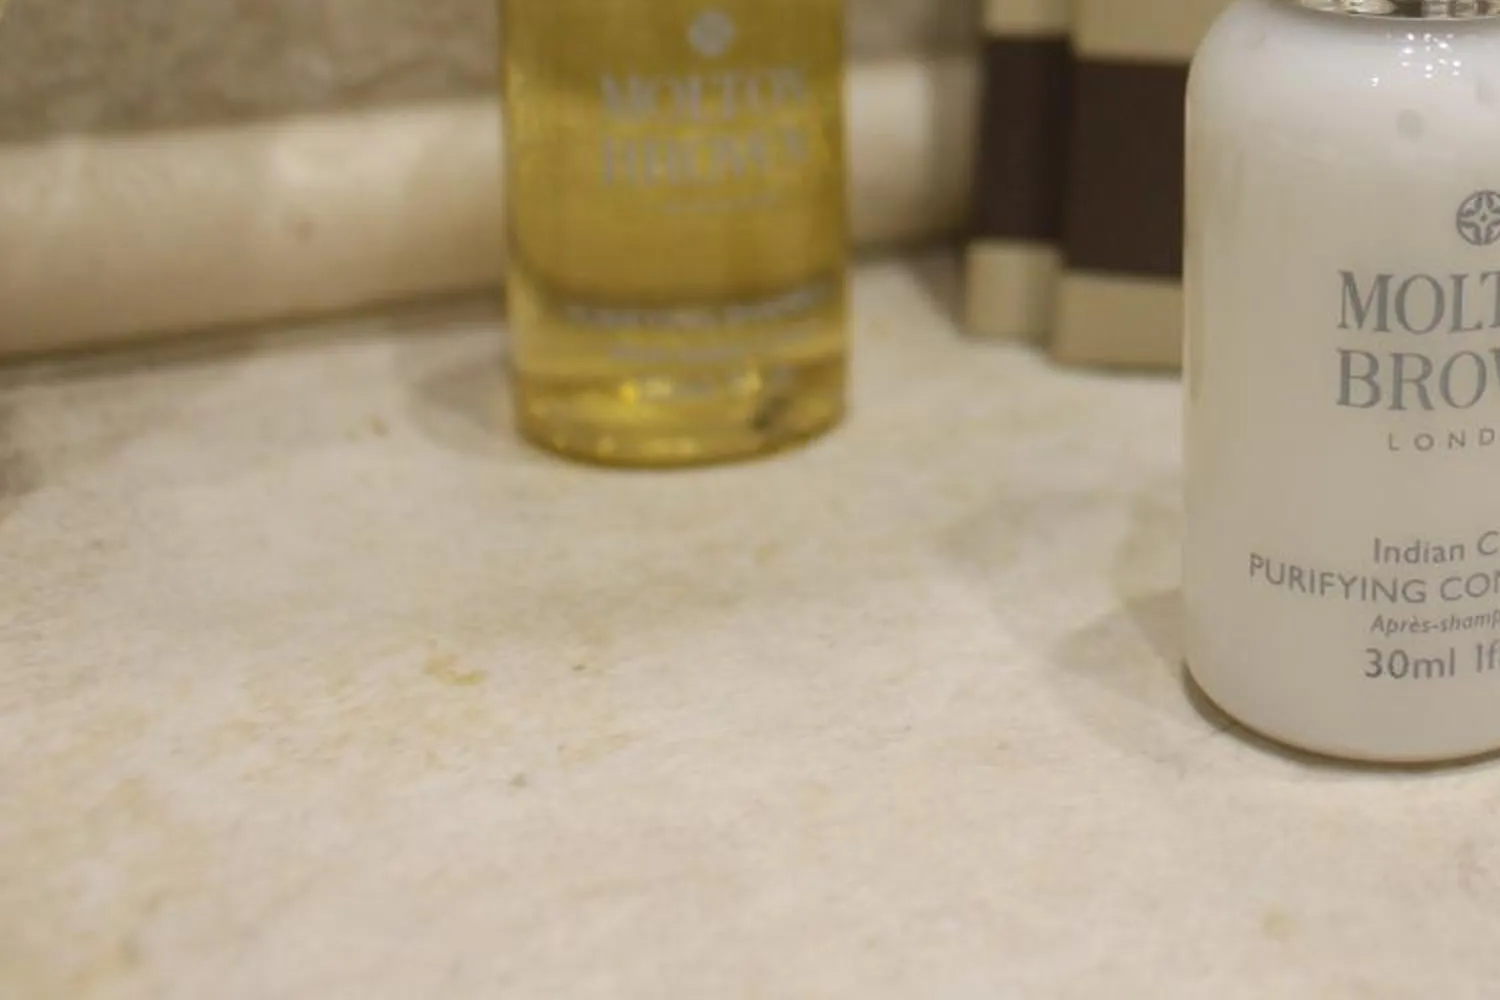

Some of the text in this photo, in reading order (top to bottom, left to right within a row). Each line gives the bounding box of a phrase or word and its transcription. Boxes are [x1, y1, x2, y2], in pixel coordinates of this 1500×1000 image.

[1373, 537, 1465, 566] Indian
[1248, 552, 1427, 604] PURIFYING
[1362, 646, 1457, 680] 30ml
